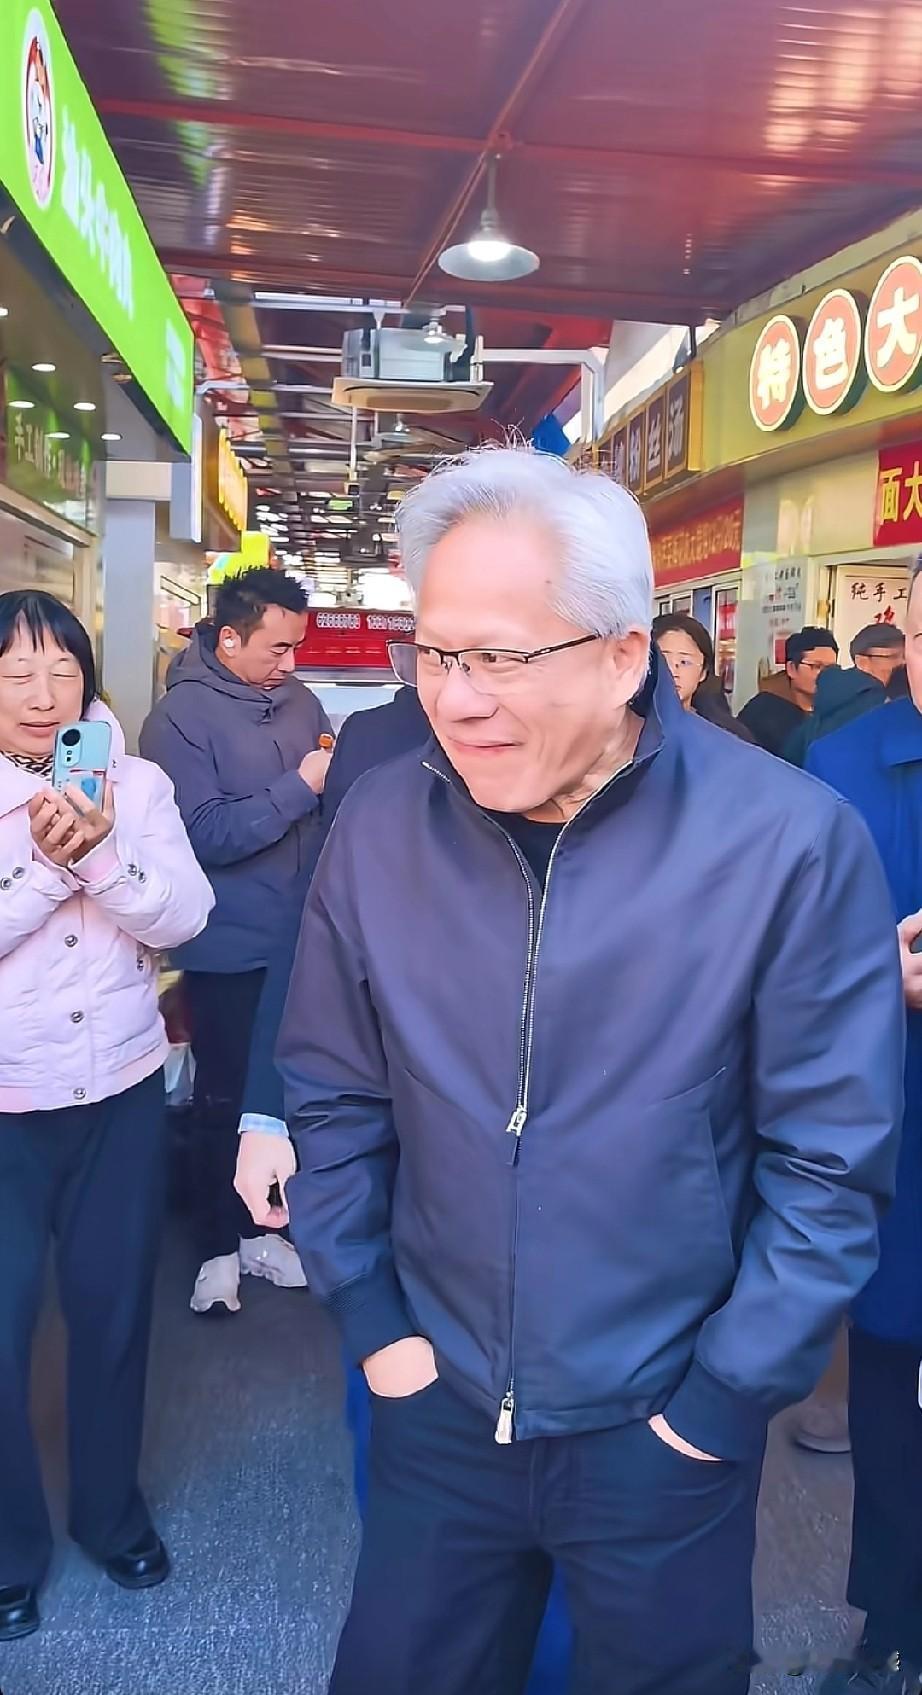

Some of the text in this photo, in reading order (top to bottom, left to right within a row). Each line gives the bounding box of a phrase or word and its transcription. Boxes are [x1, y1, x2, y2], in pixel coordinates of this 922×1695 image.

[757, 287, 920, 410] 特色大
[851, 582, 908, 602] 纯手工
